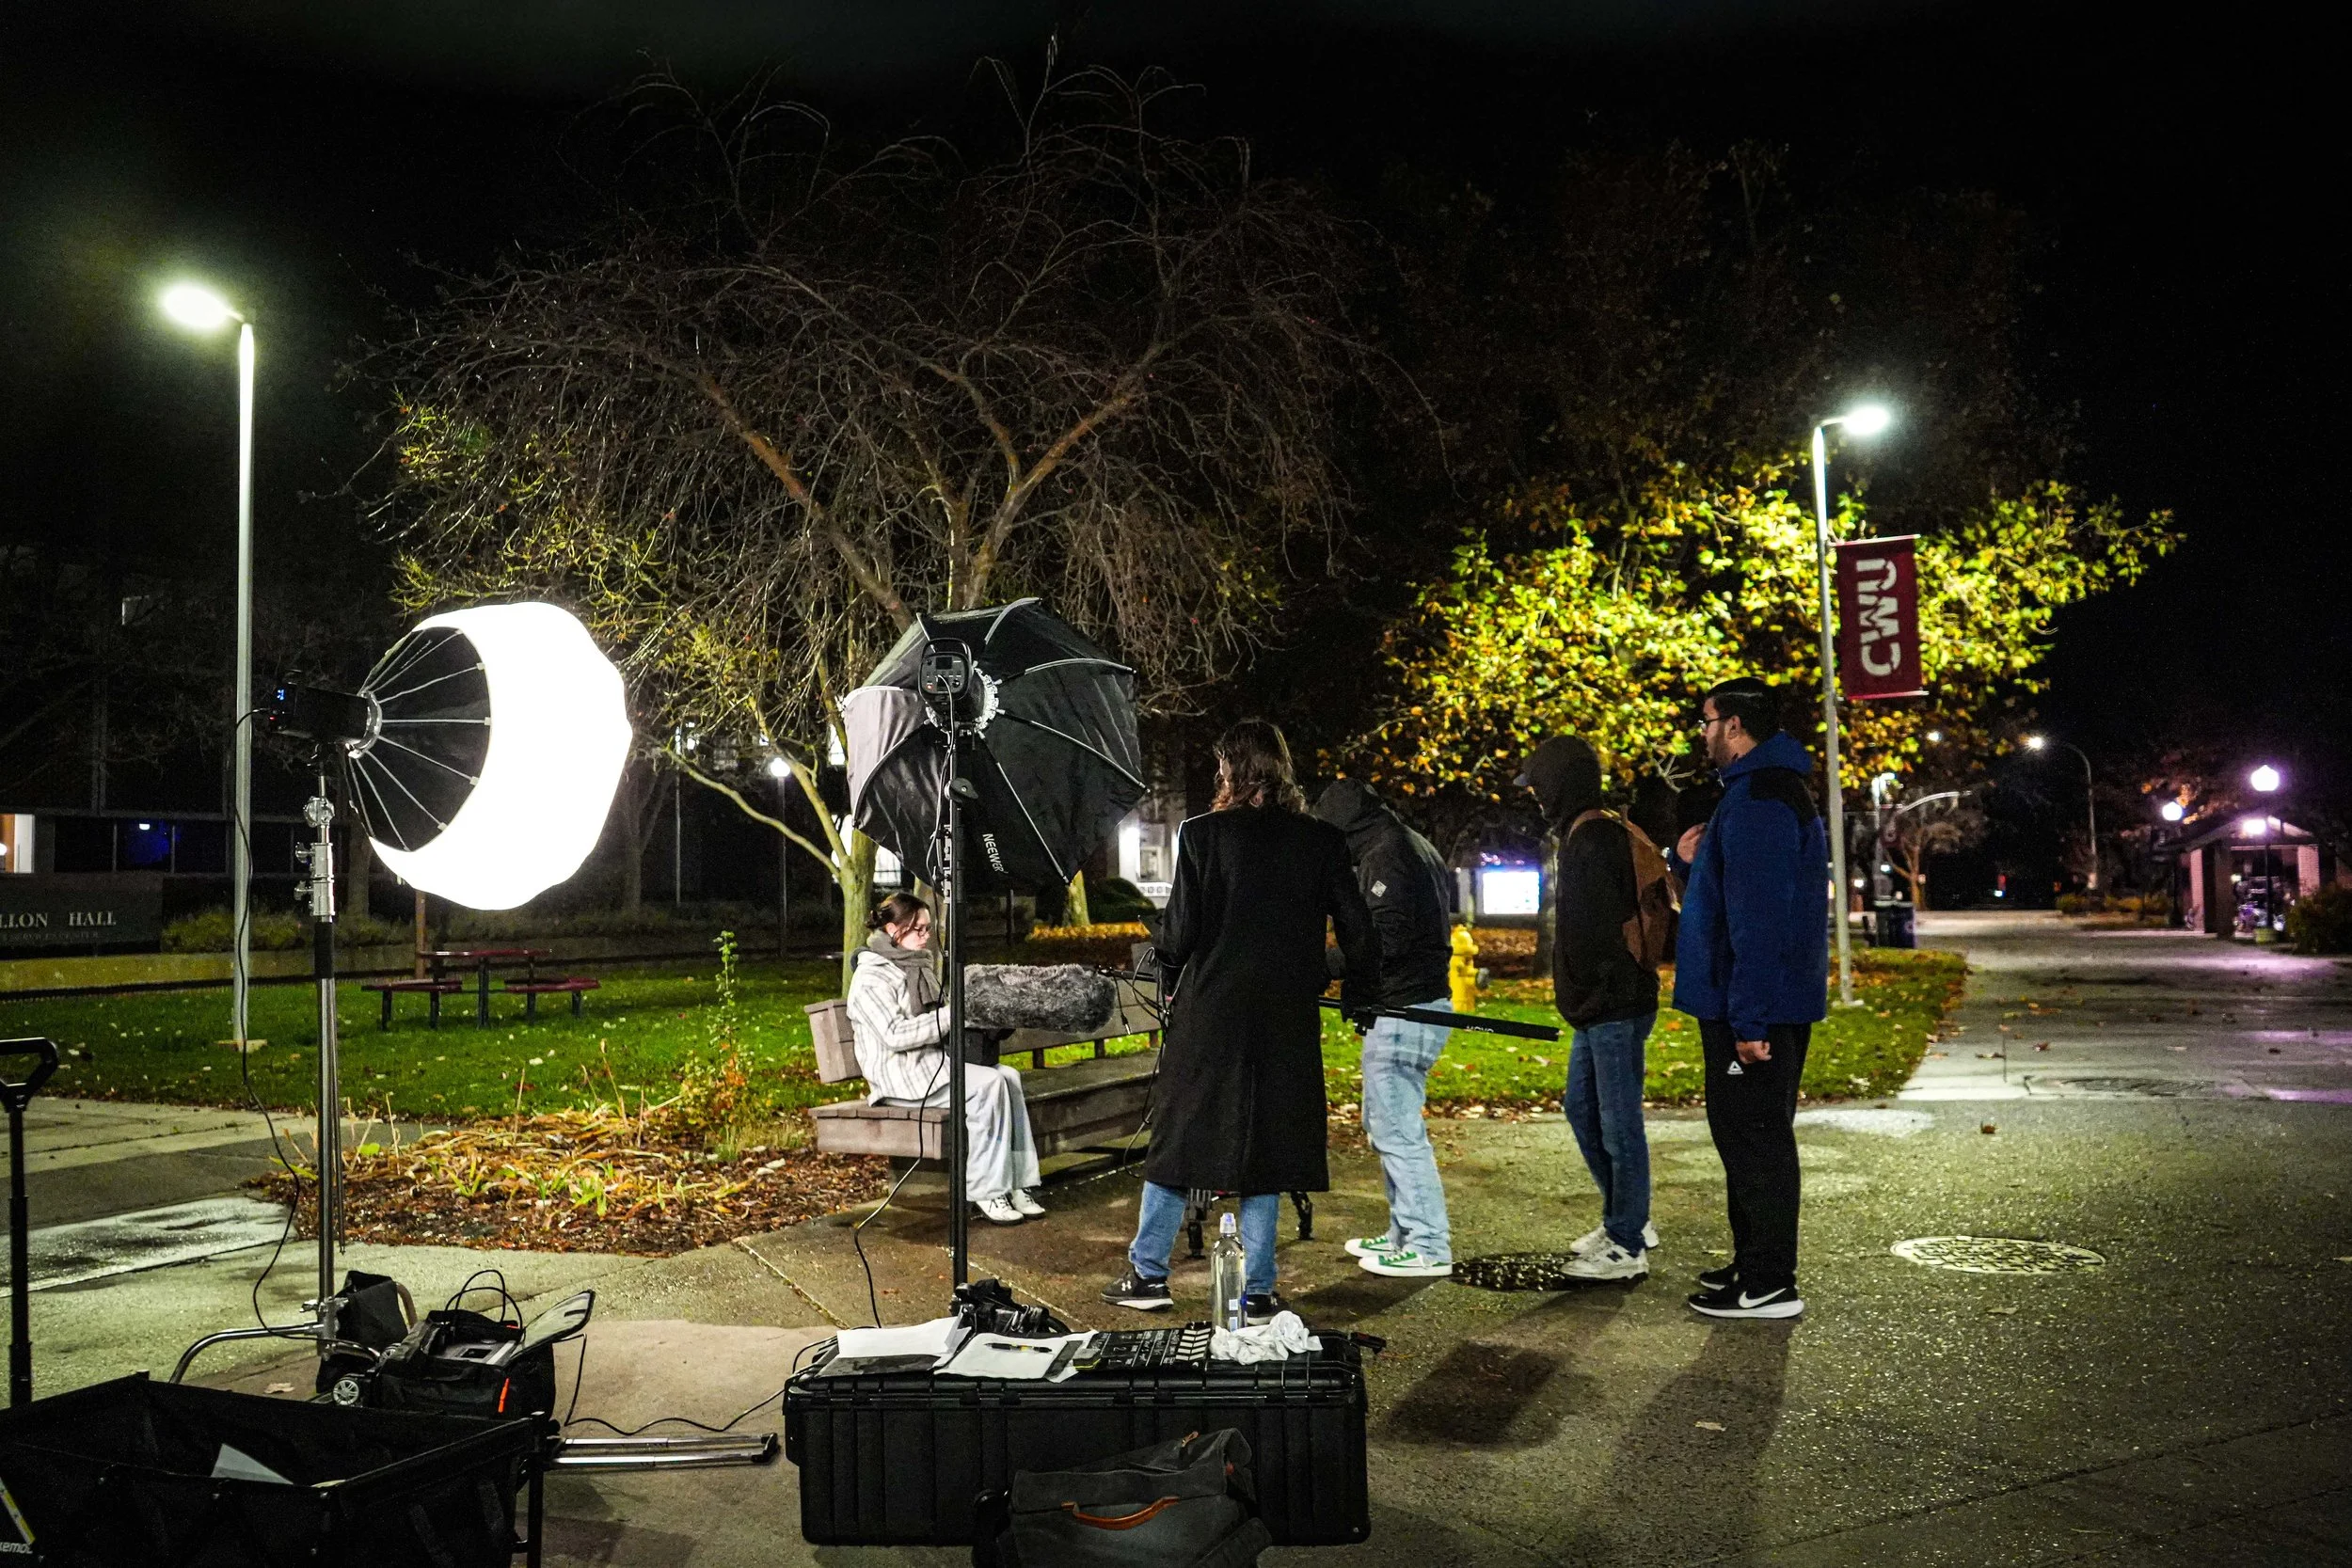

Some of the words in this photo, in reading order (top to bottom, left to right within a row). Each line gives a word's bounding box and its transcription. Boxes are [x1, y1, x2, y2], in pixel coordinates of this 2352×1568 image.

[1856, 558, 1901, 676] CMU
[982, 833, 1009, 874] NEEWER
[69, 911, 117, 927] HALL
